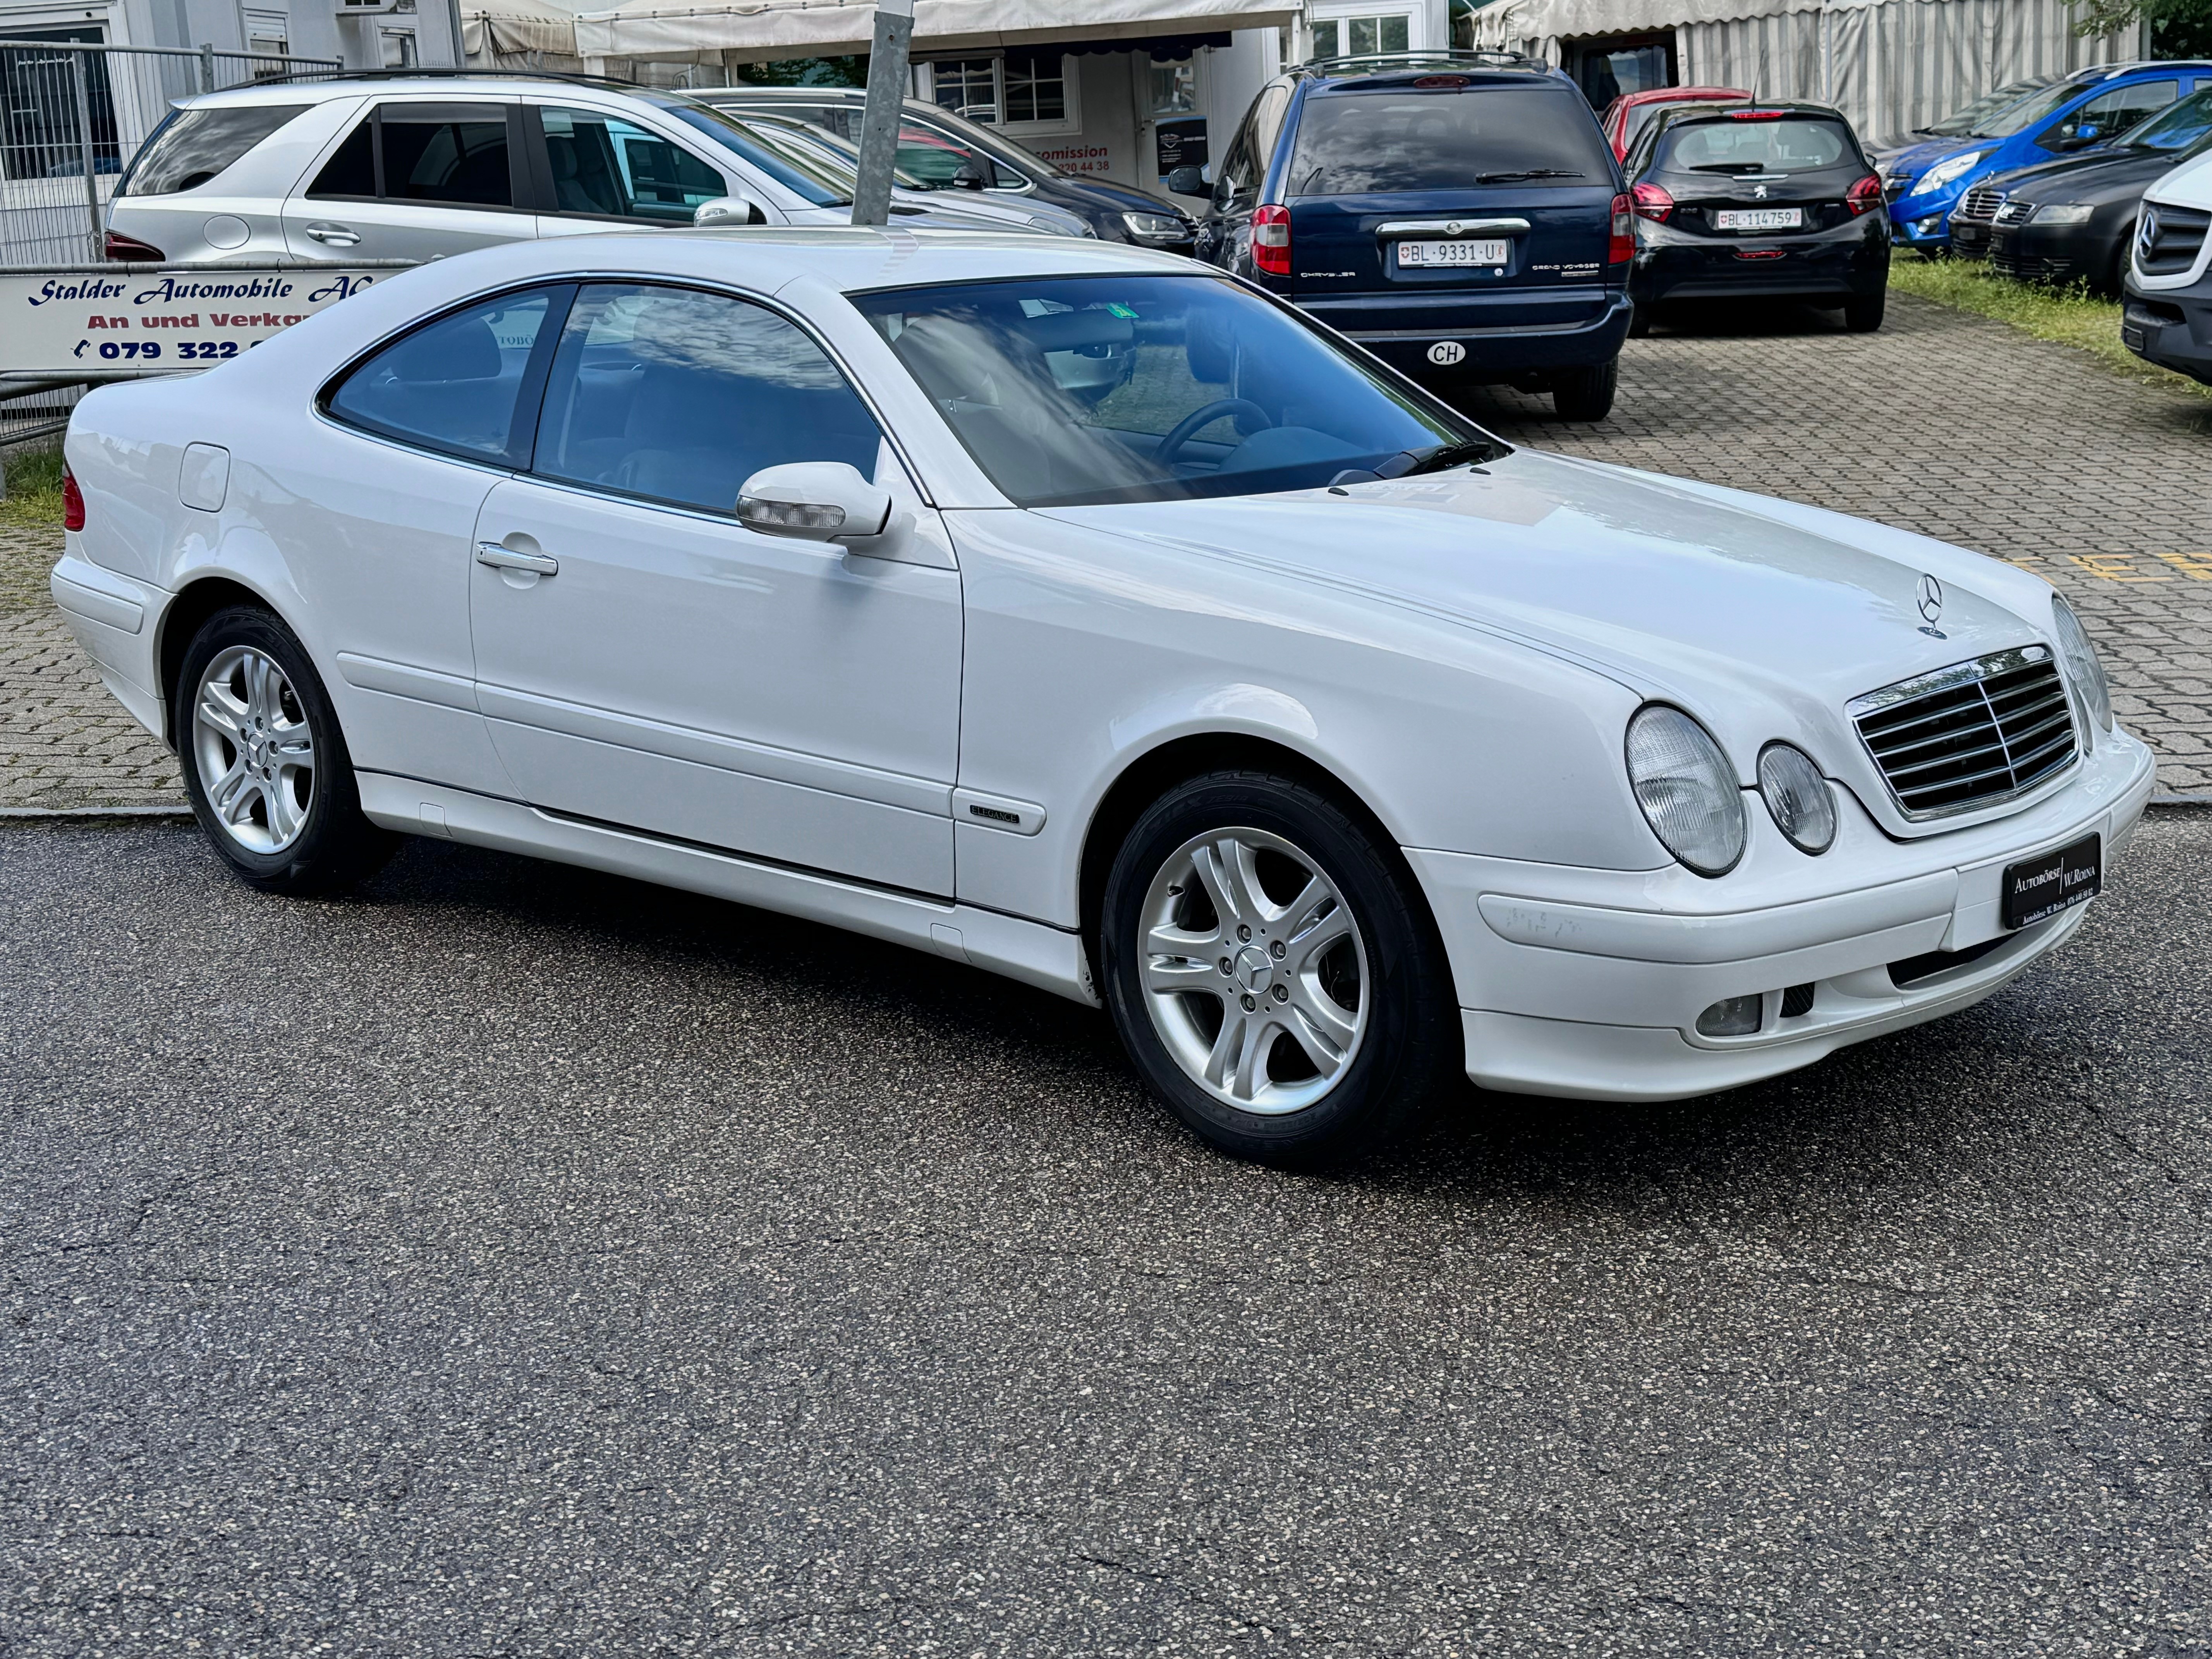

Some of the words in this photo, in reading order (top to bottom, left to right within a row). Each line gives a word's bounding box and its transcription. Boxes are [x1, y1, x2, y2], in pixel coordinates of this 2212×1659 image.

[1036, 145, 1108, 160] omission
[1080, 162, 1093, 171] 44
[1097, 161, 1109, 171] 38
[28, 278, 126, 306] Stalder
[134, 278, 293, 305] Automobile
[88, 316, 129, 329] An
[141, 314, 199, 328] und
[210, 313, 311, 327] Verka
[99, 342, 161, 359] 079
[178, 342, 239, 359] 322
[1434, 345, 1458, 361] CH
[972, 806, 1017, 823] ELEGANCE
